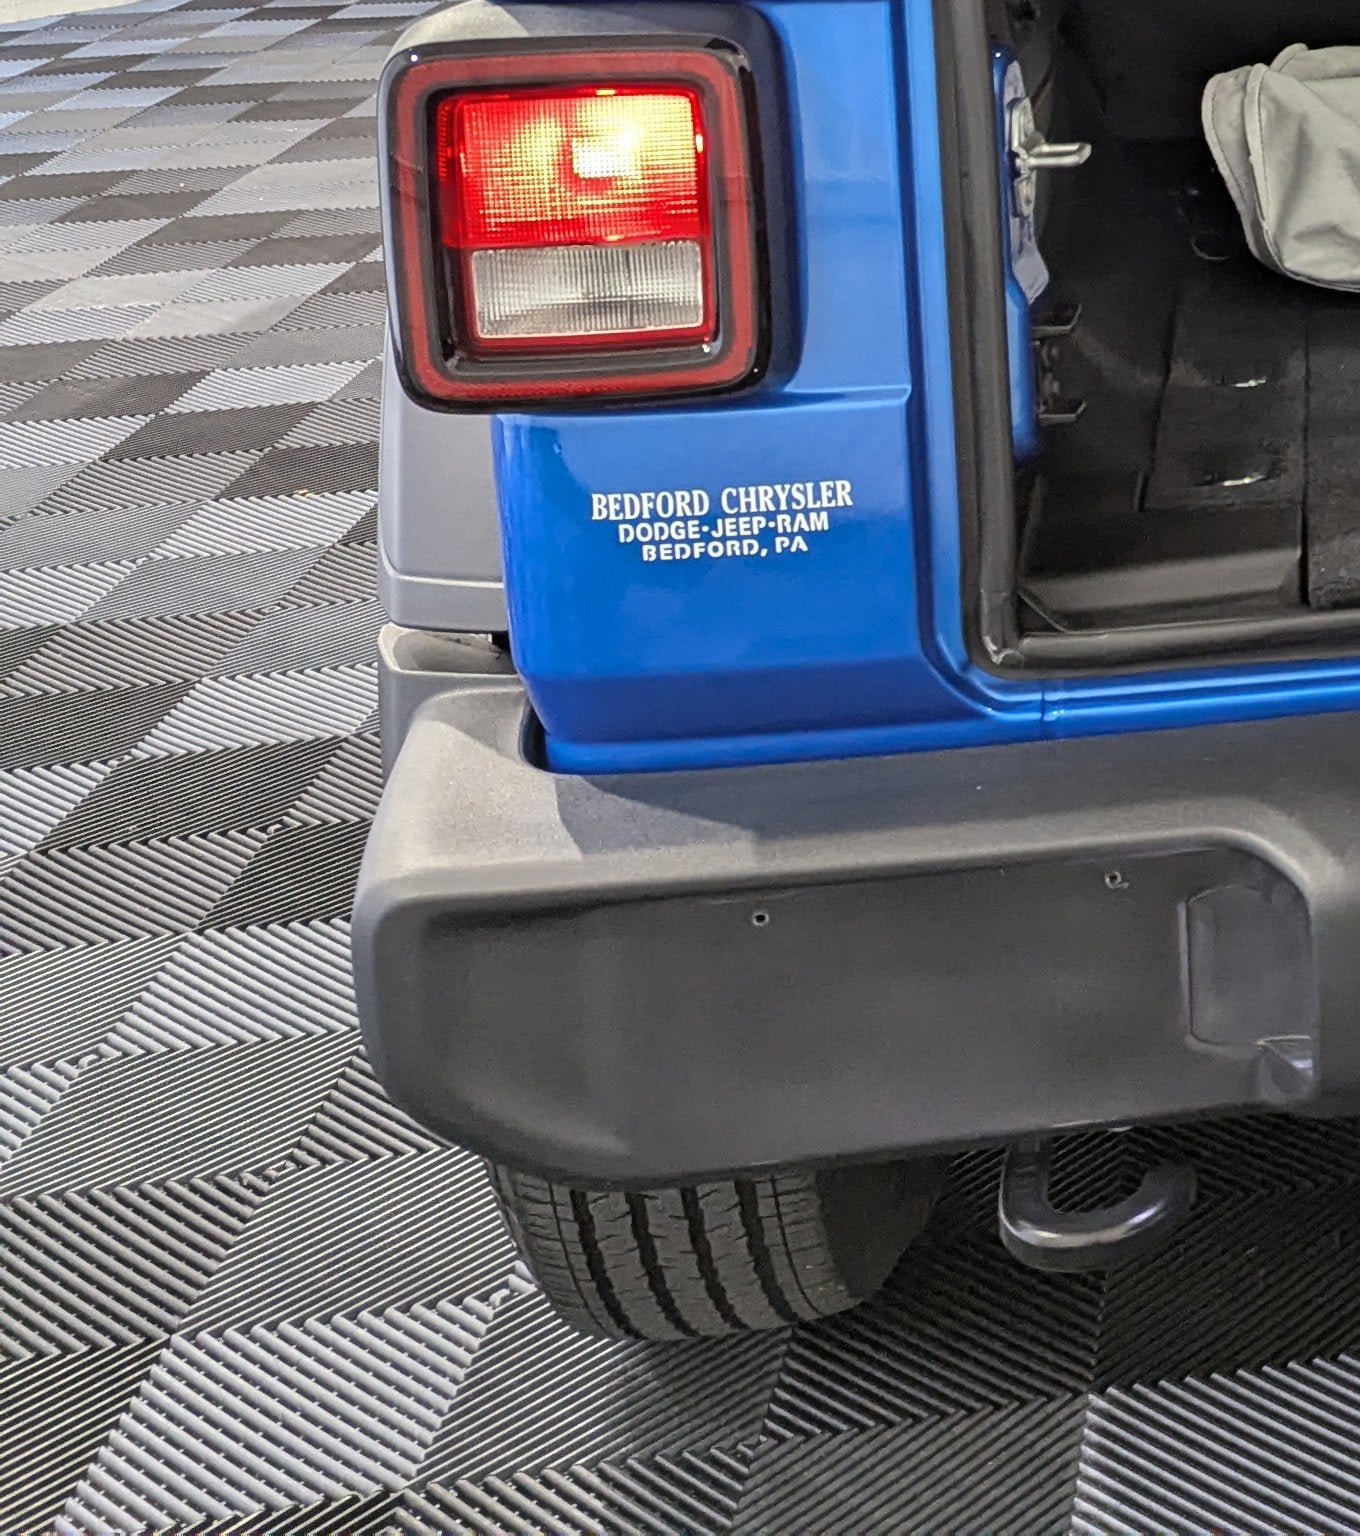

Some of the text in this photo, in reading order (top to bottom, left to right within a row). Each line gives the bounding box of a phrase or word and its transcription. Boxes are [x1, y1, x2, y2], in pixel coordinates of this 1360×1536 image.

[591, 480, 854, 521] BEDFORD CHRYSLER
[642, 536, 808, 562] BEDFORD, PA
